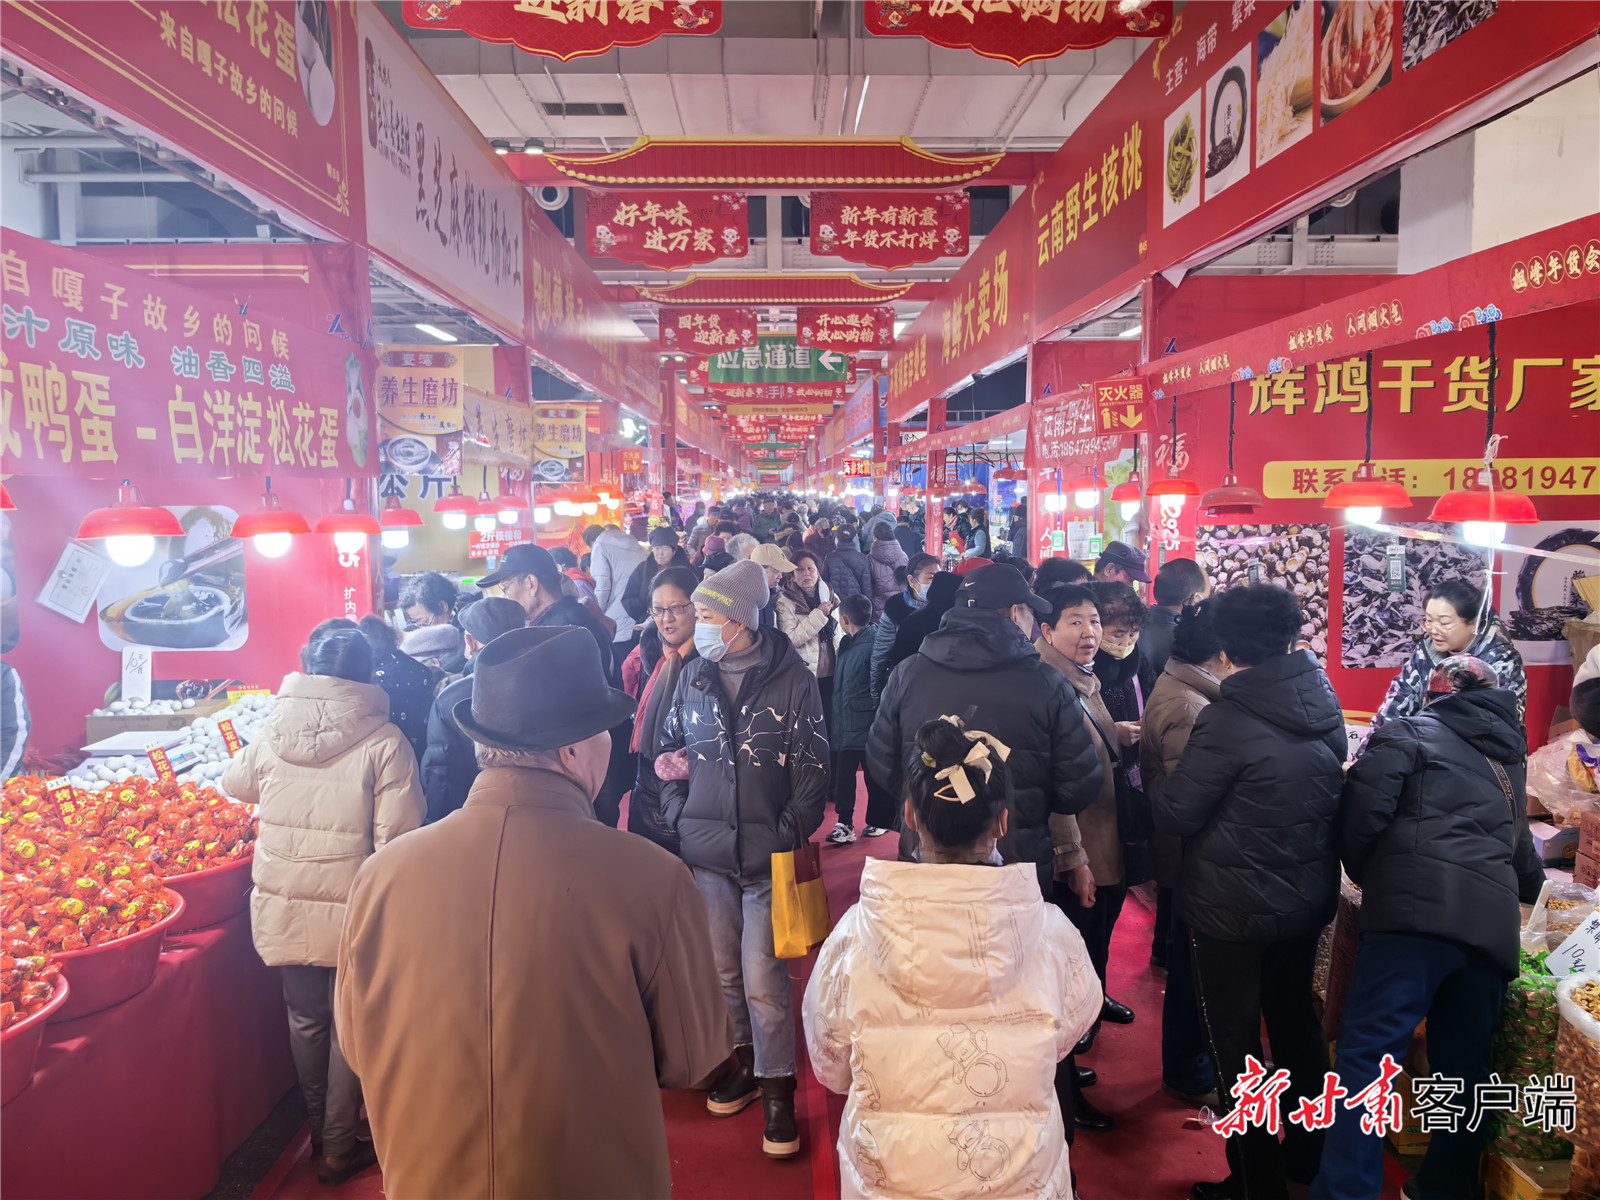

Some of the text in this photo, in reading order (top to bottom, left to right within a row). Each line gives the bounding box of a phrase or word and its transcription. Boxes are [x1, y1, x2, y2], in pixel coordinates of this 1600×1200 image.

[1196, 22, 1218, 67] 海带
[160, 10, 298, 138] 来自嘎子故乡的问候
[1037, 120, 1142, 268] 云南野生核桃
[612, 200, 693, 228] 好年味
[840, 205, 939, 226] 新年有新意
[643, 226, 716, 254] 进万家
[841, 228, 939, 250] 年货不打烊
[0, 249, 290, 361] 自嘎子故乡的问候
[941, 248, 1009, 367] 海鲜大卖场
[693, 328, 740, 346] 迎新春
[816, 327, 875, 343] 放心购物
[171, 345, 296, 394] 油香四溢
[717, 343, 811, 370] 应急通道
[381, 375, 459, 407] 养生磨坊
[1098, 384, 1144, 402] 灭火器
[535, 423, 583, 442] 养生磨坊
[1292, 465, 1598, 494] 联系话： 1881947
[220, 721, 243, 758] 松花皮
